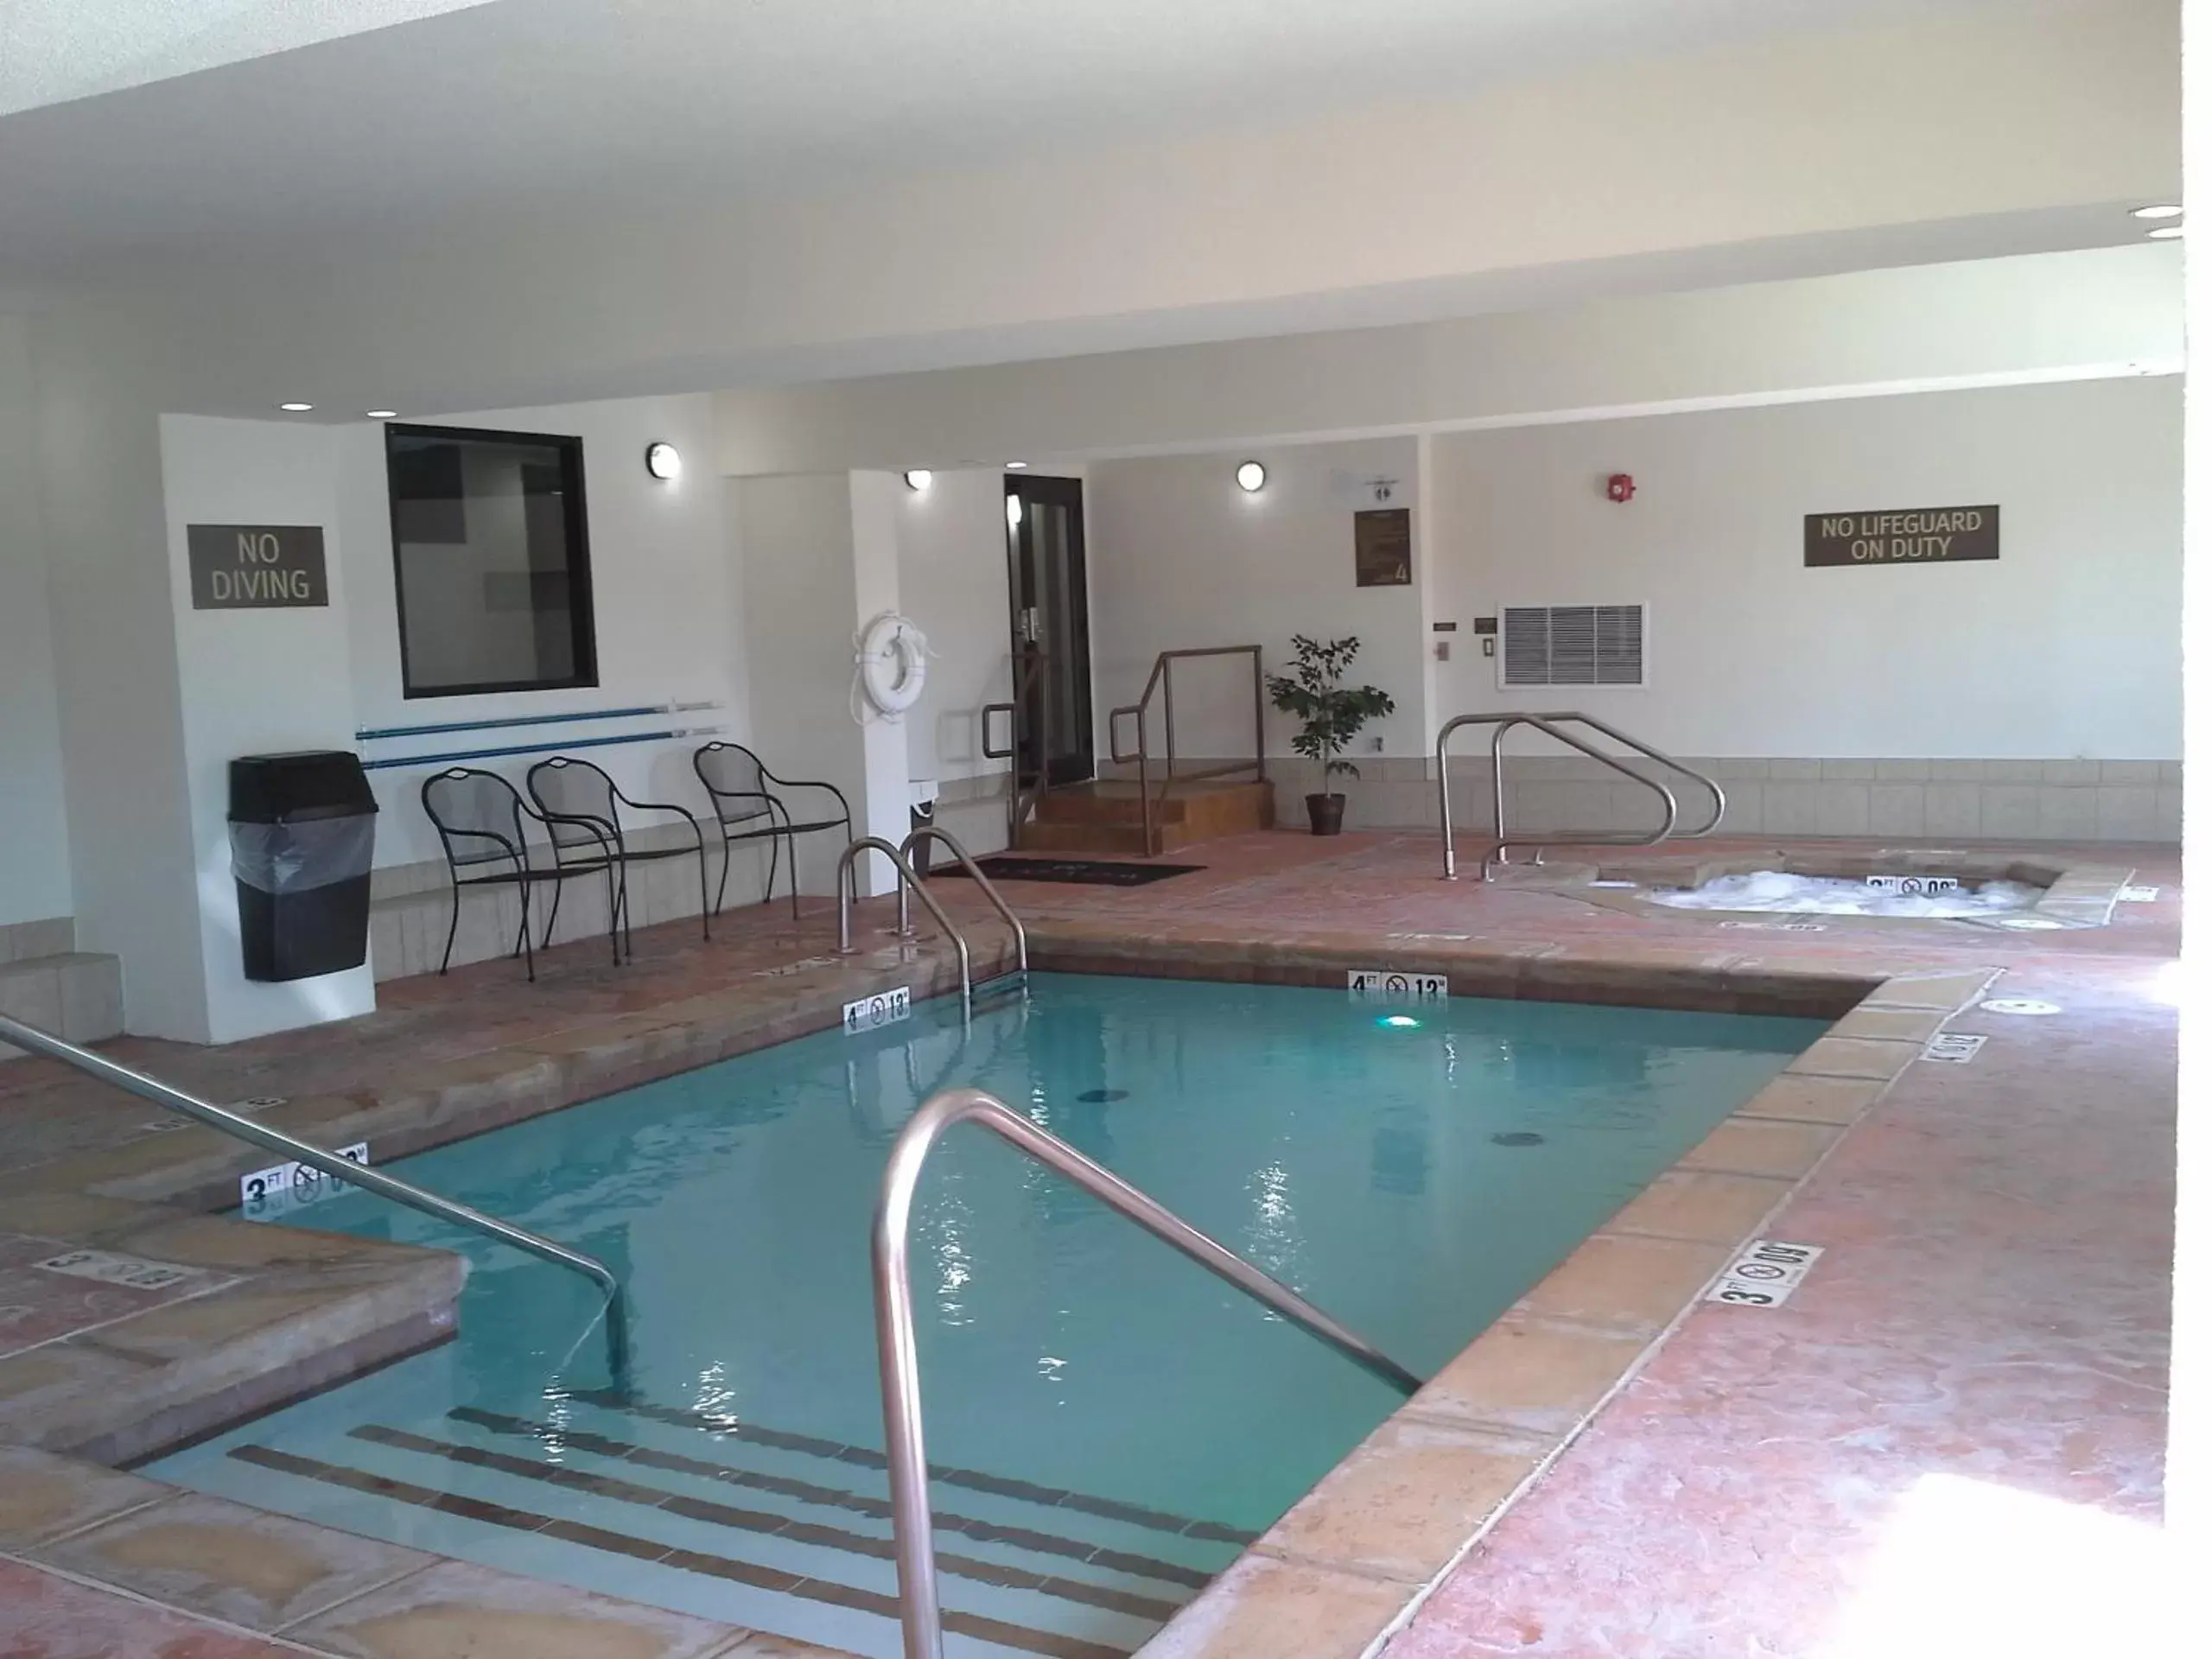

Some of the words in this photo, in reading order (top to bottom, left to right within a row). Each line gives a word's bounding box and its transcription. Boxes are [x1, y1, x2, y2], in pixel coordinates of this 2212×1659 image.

[1822, 518, 1854, 537] NO
[1861, 512, 1981, 536] LIFEGUARD
[238, 533, 279, 563] NO
[1851, 541, 1884, 560] ON
[1891, 537, 1953, 558] DUTY
[212, 569, 309, 600] DIVING
[268, 1173, 283, 1186] FT
[1720, 1291, 1773, 1305] 3
[1754, 1247, 1809, 1264] 09
